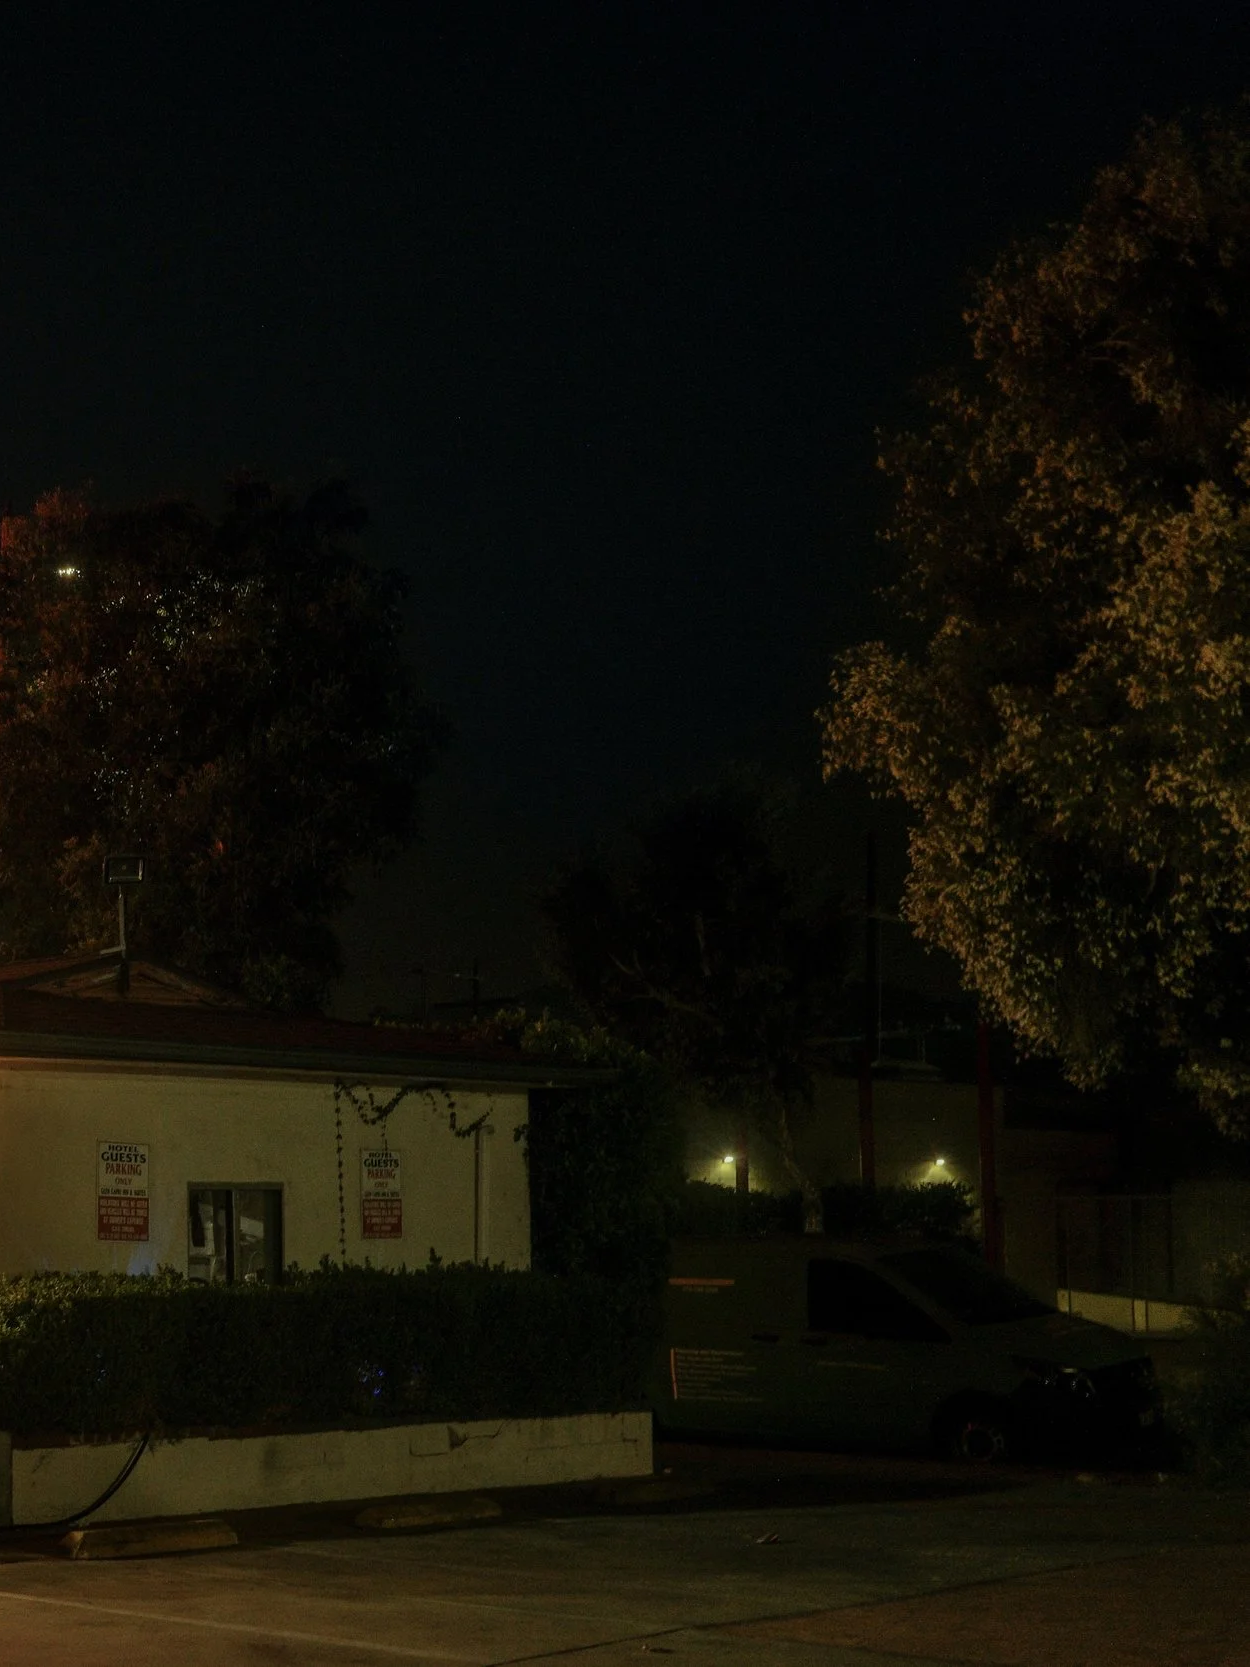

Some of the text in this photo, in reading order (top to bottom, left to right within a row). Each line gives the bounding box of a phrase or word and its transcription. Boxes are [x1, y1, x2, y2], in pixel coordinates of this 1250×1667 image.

[108, 1144, 138, 1152] HOTEL
[101, 1152, 146, 1163] GUESTS
[364, 1158, 399, 1168] GUESTS
[105, 1162, 142, 1176] PARKING
[367, 1168, 396, 1179] PARKING
[115, 1177, 132, 1185] ONLY
